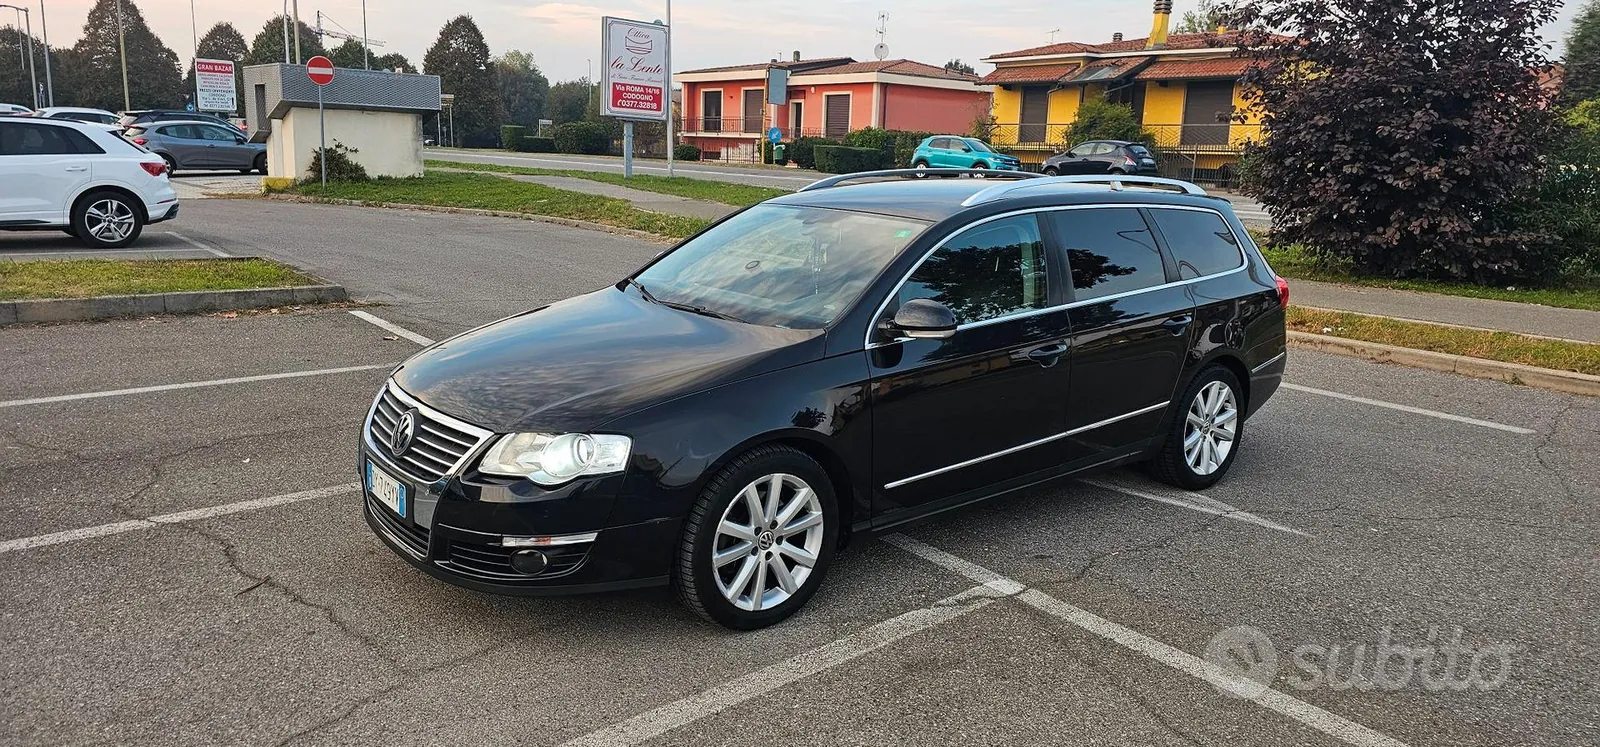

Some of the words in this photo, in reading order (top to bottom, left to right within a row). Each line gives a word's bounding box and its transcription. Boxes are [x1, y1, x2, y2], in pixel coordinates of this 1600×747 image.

[627, 27, 651, 39] Ottica
[611, 55, 625, 70] la
[626, 56, 664, 74] Lente
[626, 85, 644, 93] ROMA
[622, 92, 653, 101] CODOGNO
